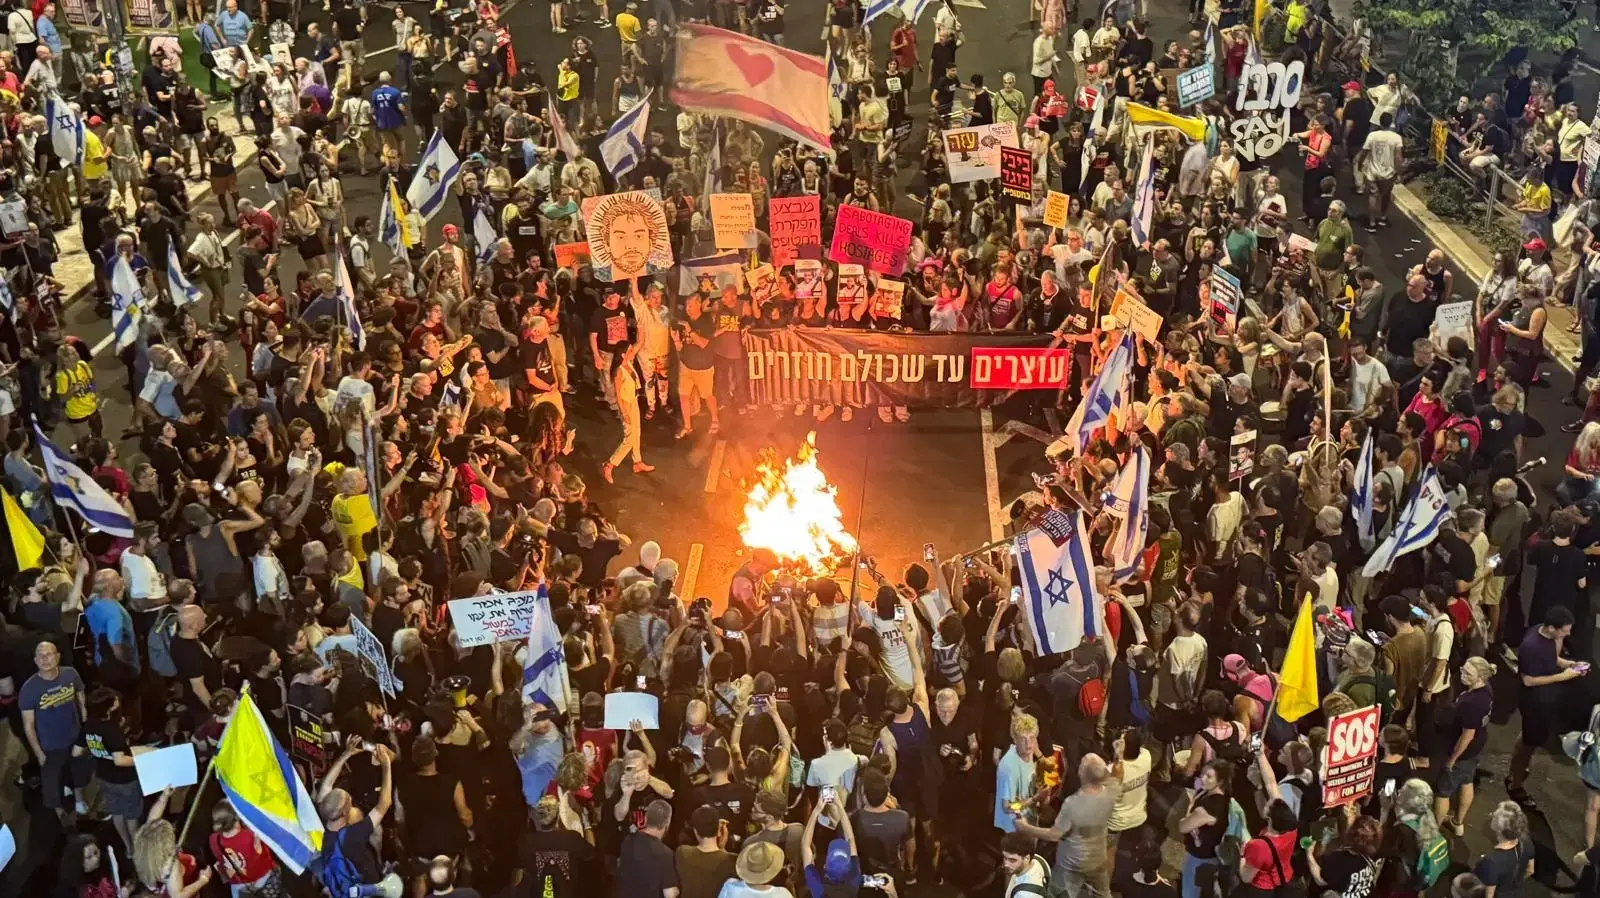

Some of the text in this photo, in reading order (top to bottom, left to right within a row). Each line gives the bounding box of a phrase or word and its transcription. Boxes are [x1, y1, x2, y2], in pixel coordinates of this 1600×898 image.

[1230, 108, 1290, 147] SAY
[1233, 133, 1283, 162] NO
[1003, 152, 1031, 172] ביבי
[1002, 168, 1030, 187] בוגד
[773, 201, 815, 216] מבצע
[841, 207, 911, 235] SABOTAGING
[775, 218, 818, 238] הפקרת
[839, 222, 906, 248] DEALS KILLS
[839, 240, 898, 267] HOSTAGES
[748, 349, 1065, 383] עוצרים עד שכולם חוזרים
[489, 608, 506, 620] את
[1332, 712, 1377, 763] SOS
[1342, 786, 1355, 797] FOR
